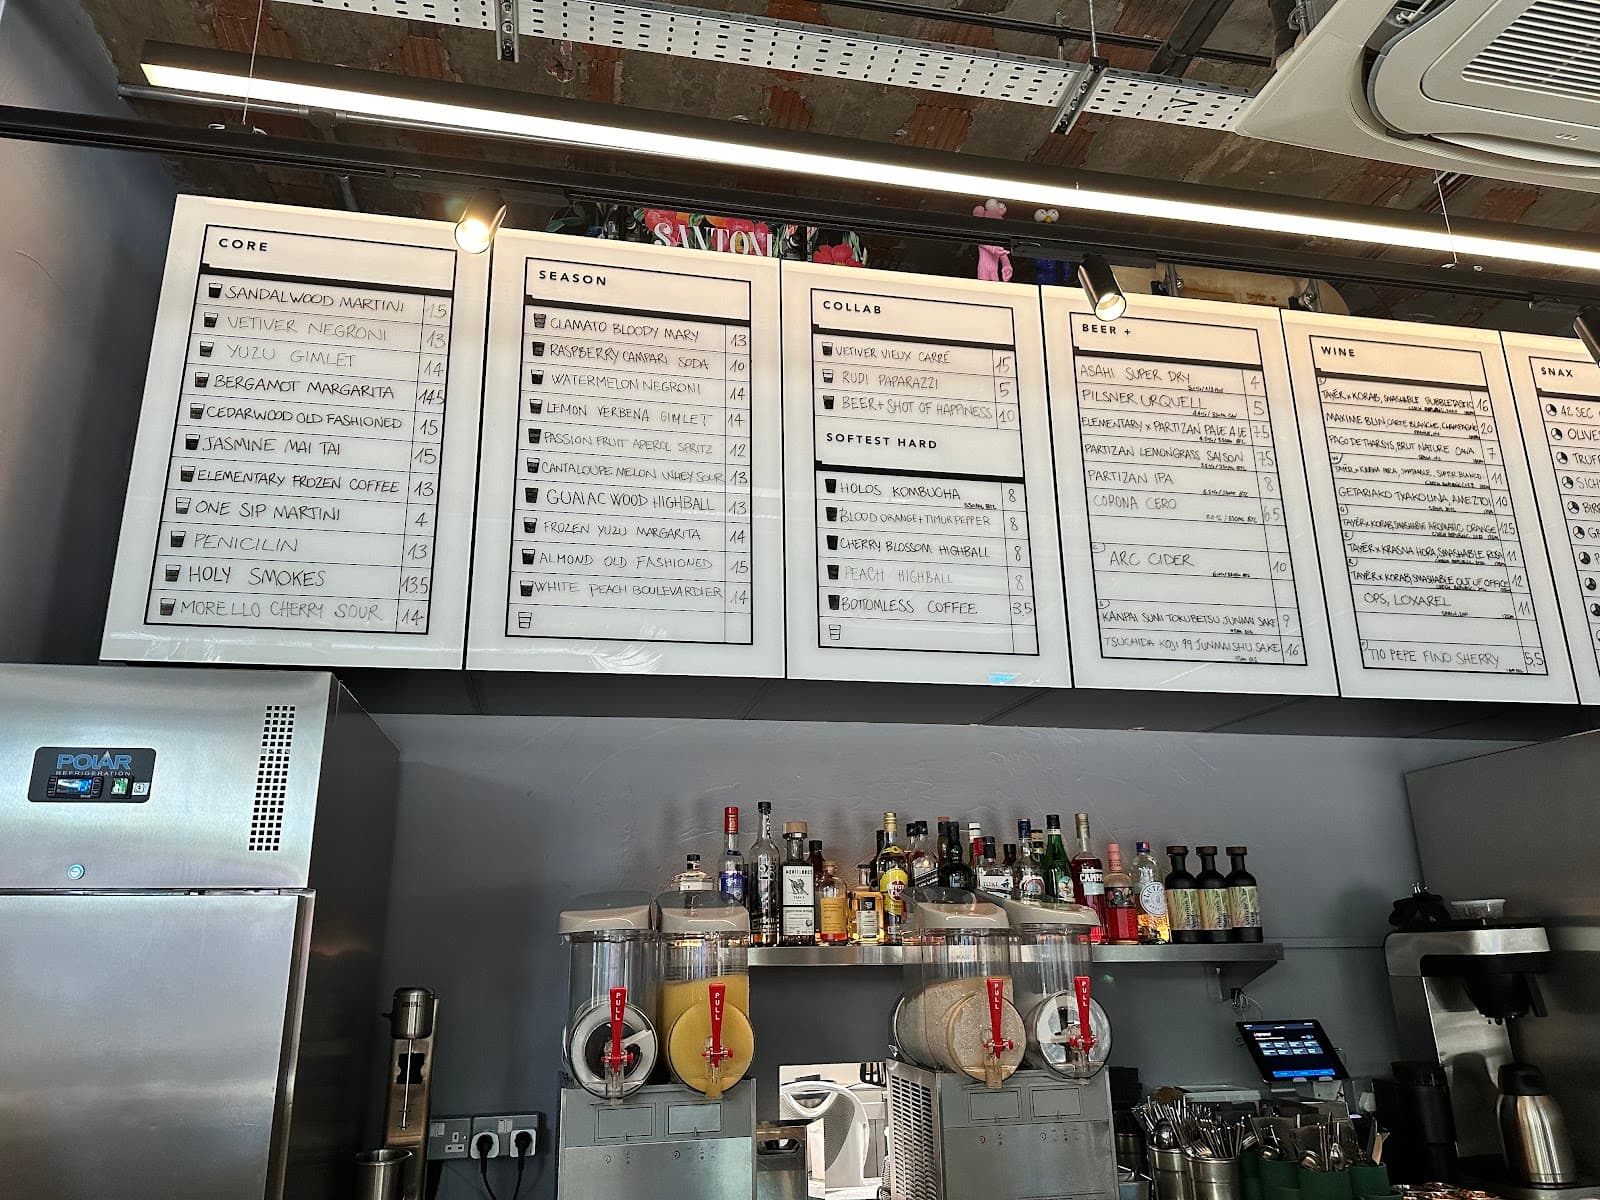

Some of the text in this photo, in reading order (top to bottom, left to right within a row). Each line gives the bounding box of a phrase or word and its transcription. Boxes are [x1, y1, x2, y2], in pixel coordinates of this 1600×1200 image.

[219, 238, 268, 252] CORE
[539, 271, 607, 285] SEASON
[225, 286, 404, 312] SANDALWOOD MARTINI
[823, 301, 881, 314] COLLAB
[228, 316, 386, 342] VETIVER NEGRONI
[550, 317, 747, 346] CLAMATO BLOODY MARY 13
[1083, 324, 1116, 335] BEER
[228, 345, 356, 368] YUZU GIMLET
[550, 344, 709, 369] RASPBERRY CAMPARI SODA
[835, 346, 877, 358] VETIVER
[881, 350, 911, 360] VIEUX
[1321, 346, 1355, 357] WINE
[842, 371, 938, 390] RUDI PAPARAZZI
[1081, 364, 1189, 384] ASAHI SUPER DRY
[1541, 367, 1573, 377] SNAX
[214, 374, 394, 399] BERGAMOT MARGARITA
[552, 374, 700, 395] WATERMELON NEGRONI
[887, 398, 914, 413] SHOT
[919, 403, 931, 415] OF
[936, 404, 992, 419] HAPPINESS
[1082, 389, 1138, 404] PILSNER
[1141, 394, 1207, 410] URQUELL
[1254, 401, 1265, 415] 5
[206, 407, 438, 436] CEDARWOOD OLD FASHIONED 15
[546, 401, 712, 426] LEMON VERBENA GIMLET
[1576, 407, 1593, 418] SEC
[1082, 416, 1143, 431] ELEMENTARY
[1154, 421, 1201, 435] PARTIZAN
[1481, 424, 1493, 435] 20
[202, 437, 340, 455] JASMINE MAI TAI
[544, 432, 713, 454] PASSION FRUIT APEROL SPRITZ
[826, 433, 937, 449] SOFTEST HARD
[1329, 435, 1349, 445] PAGO
[1418, 442, 1450, 454] NATURE
[1488, 448, 1496, 461] 7
[1085, 443, 1243, 462] PARTIZAN LEMONGRASS SAISON
[542, 462, 748, 484] CANTALOUPE MELON WHEY SOUR 13
[1088, 470, 1174, 484] PARTIZAN IPA
[198, 470, 434, 496] ELEMENTARY FROZEN COFFEE 13
[840, 482, 960, 500] HOLOS KOMBUCHA
[546, 488, 715, 511] GUAIAC WOOD HIGHBALL
[1093, 494, 1176, 510] CORONA CERO
[1339, 486, 1508, 506] GETARIAKO 10
[195, 500, 340, 520] ONE SIP MARTINI
[840, 506, 990, 526] BLOOD TIMUR PEPPER
[543, 521, 701, 540] FROZEN YUZU MARGARITA
[194, 534, 298, 552] PENICILIN
[840, 538, 990, 558] CHERRY BLOSSOM HIGHBALL
[539, 552, 712, 569] ALMOND OLD FASHIONED
[1110, 550, 1287, 572] ARC CIDER 10
[189, 566, 326, 586] HOLY SMOKES
[845, 565, 952, 583] PEACH HIGHBALL
[533, 581, 723, 598] WHITE PEACH BOULEVARDIER
[841, 599, 977, 614] BOTTOMLESS COFFEE
[1394, 594, 1451, 606] LOXAREL
[181, 600, 383, 620] MORELLO CHERRY SOUR
[1102, 612, 1138, 623] KANPAI
[1142, 613, 1164, 623] SUMI
[1167, 614, 1220, 623] TOKUBETSU
[1259, 618, 1276, 627] SAKE
[1159, 640, 1178, 650] KOJI
[1256, 642, 1281, 653] SAKE
[1370, 648, 1500, 669] TIO PEPE FINO SHERRY
[56, 750, 132, 770] POLAR
